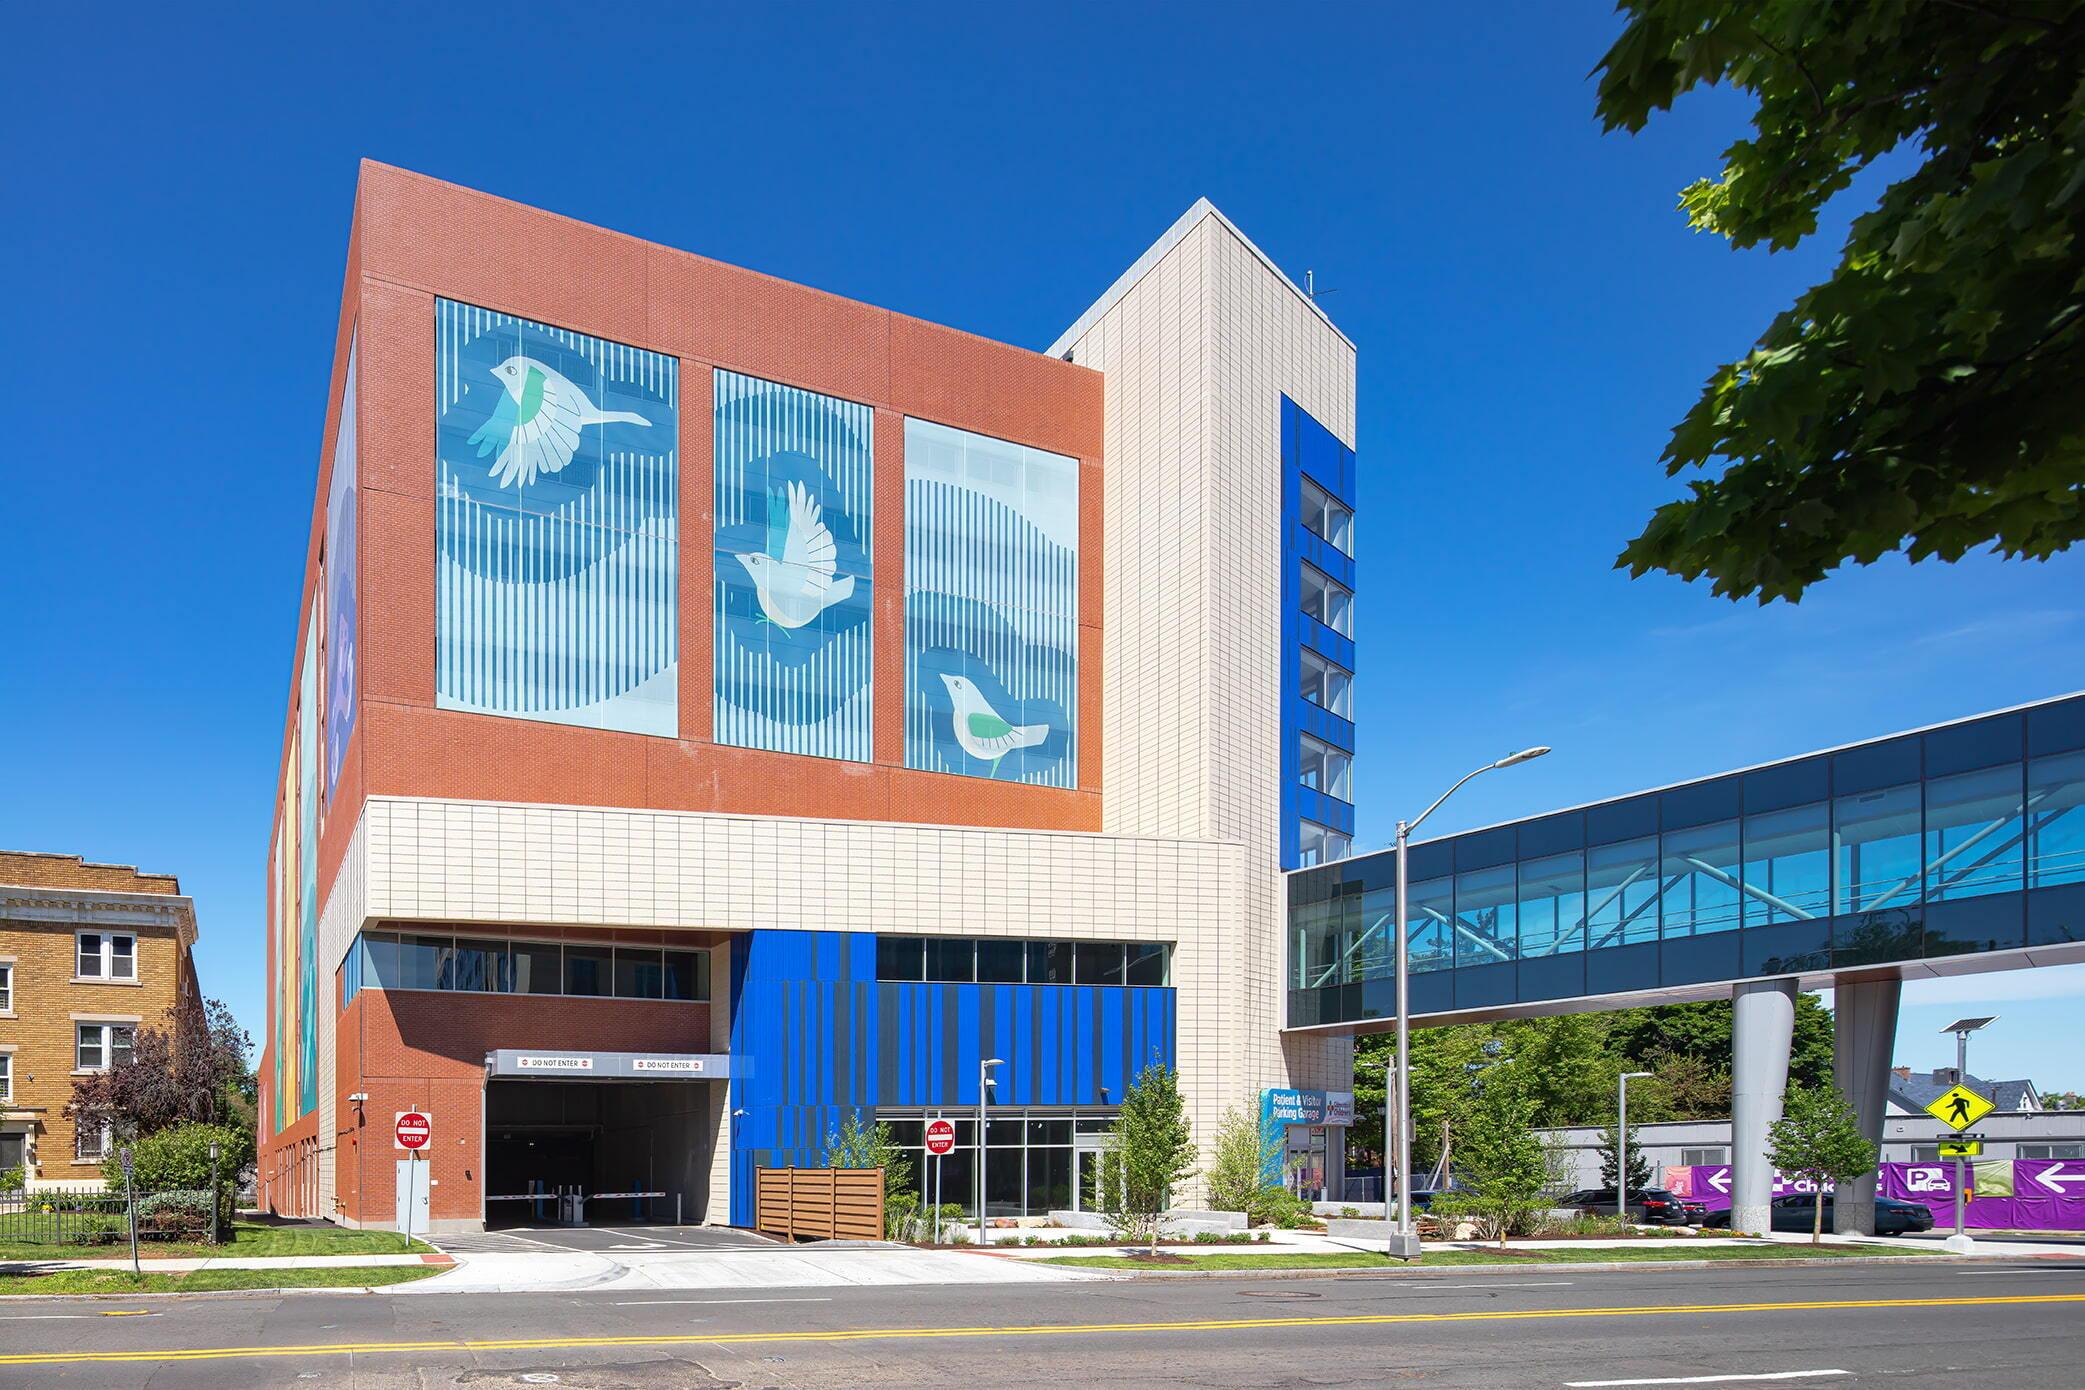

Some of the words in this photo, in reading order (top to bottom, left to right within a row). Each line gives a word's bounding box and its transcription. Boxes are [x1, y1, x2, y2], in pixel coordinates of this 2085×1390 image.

[543, 1059, 556, 1067] NOT
[1273, 1093, 1296, 1106] Patient
[1296, 1094, 1301, 1106] &
[1302, 1095, 1321, 1106] Visitor
[1273, 1107, 1296, 1120] Parking
[1298, 1107, 1319, 1120] Garage
[1911, 1171, 1928, 1185] P
